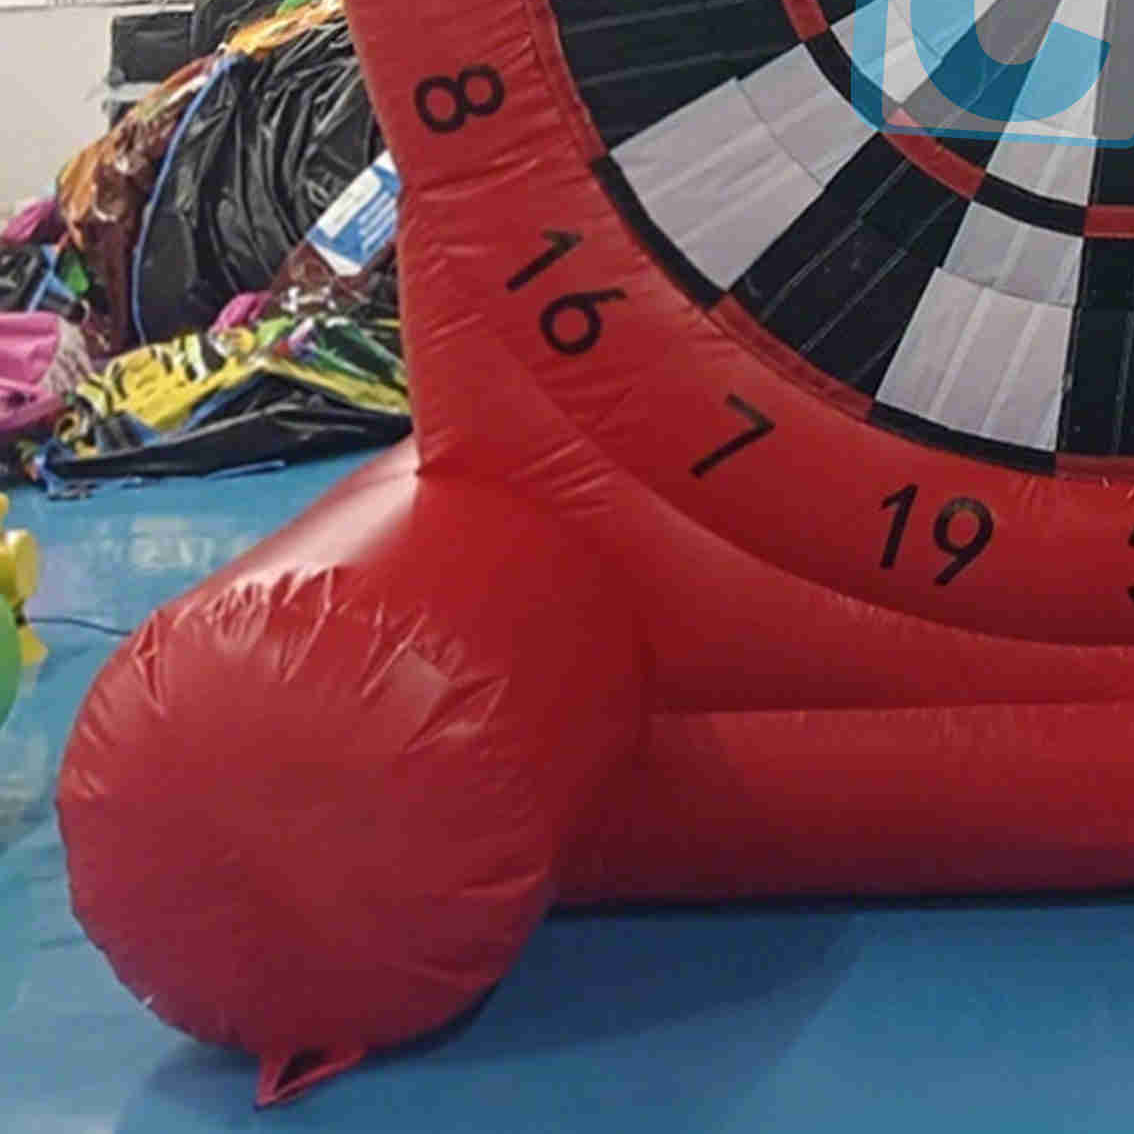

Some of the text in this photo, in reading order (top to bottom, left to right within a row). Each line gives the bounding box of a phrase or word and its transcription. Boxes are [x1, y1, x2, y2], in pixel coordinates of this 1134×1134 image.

[414, 64, 506, 134] 8
[506, 227, 627, 357] 16
[690, 395, 776, 479] 7
[880, 484, 994, 586] 19
